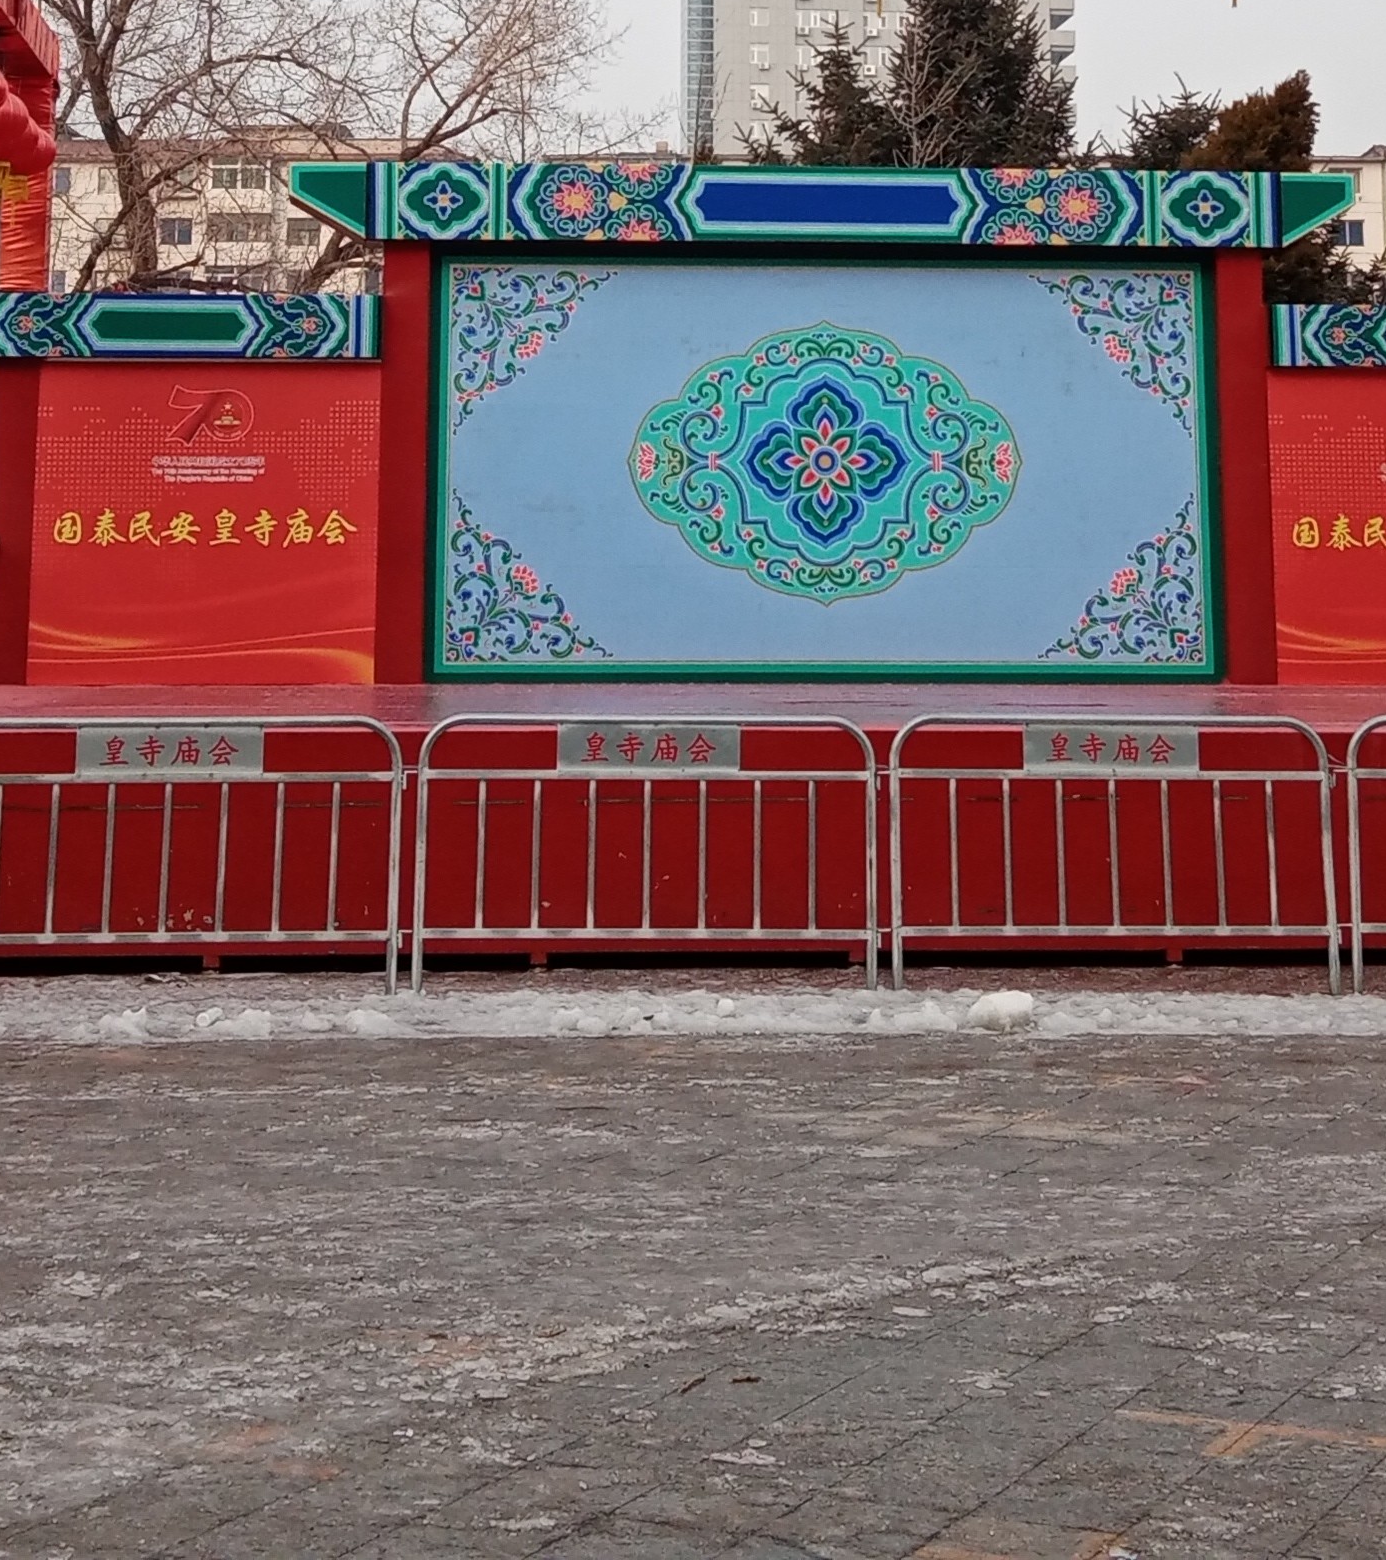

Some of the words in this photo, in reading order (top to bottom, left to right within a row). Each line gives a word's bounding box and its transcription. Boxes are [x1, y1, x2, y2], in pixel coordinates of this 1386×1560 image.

[53, 509, 358, 547] 国泰民安皇寺庙会
[99, 736, 239, 766] 皇寺庙会
[581, 732, 717, 764] 皇寺庙会
[1046, 733, 1176, 763] 皇寺庙会
